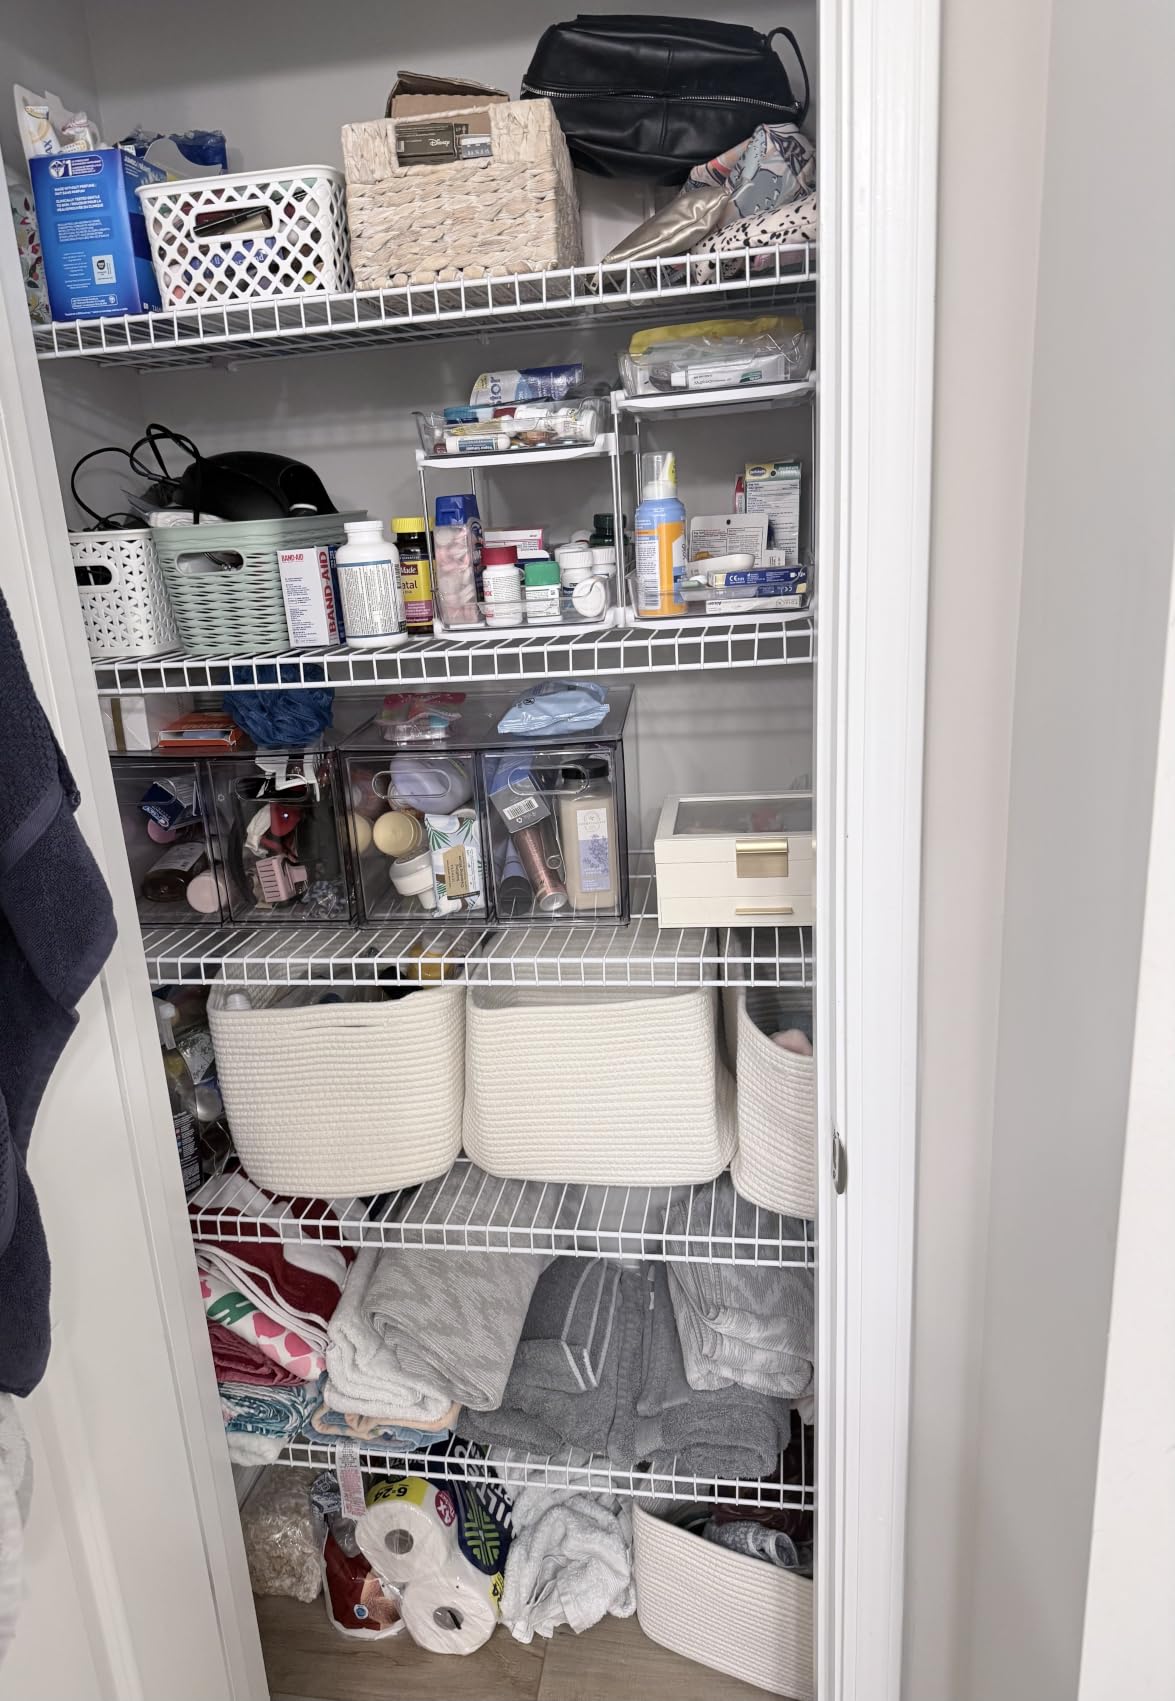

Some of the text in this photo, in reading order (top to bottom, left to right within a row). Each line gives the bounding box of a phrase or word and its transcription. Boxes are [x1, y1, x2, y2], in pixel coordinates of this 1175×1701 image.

[428, 138, 450, 147] Disney
[281, 553, 304, 562] BAND-AID
[402, 580, 418, 590] atal
[318, 551, 338, 634] BAND-AID
